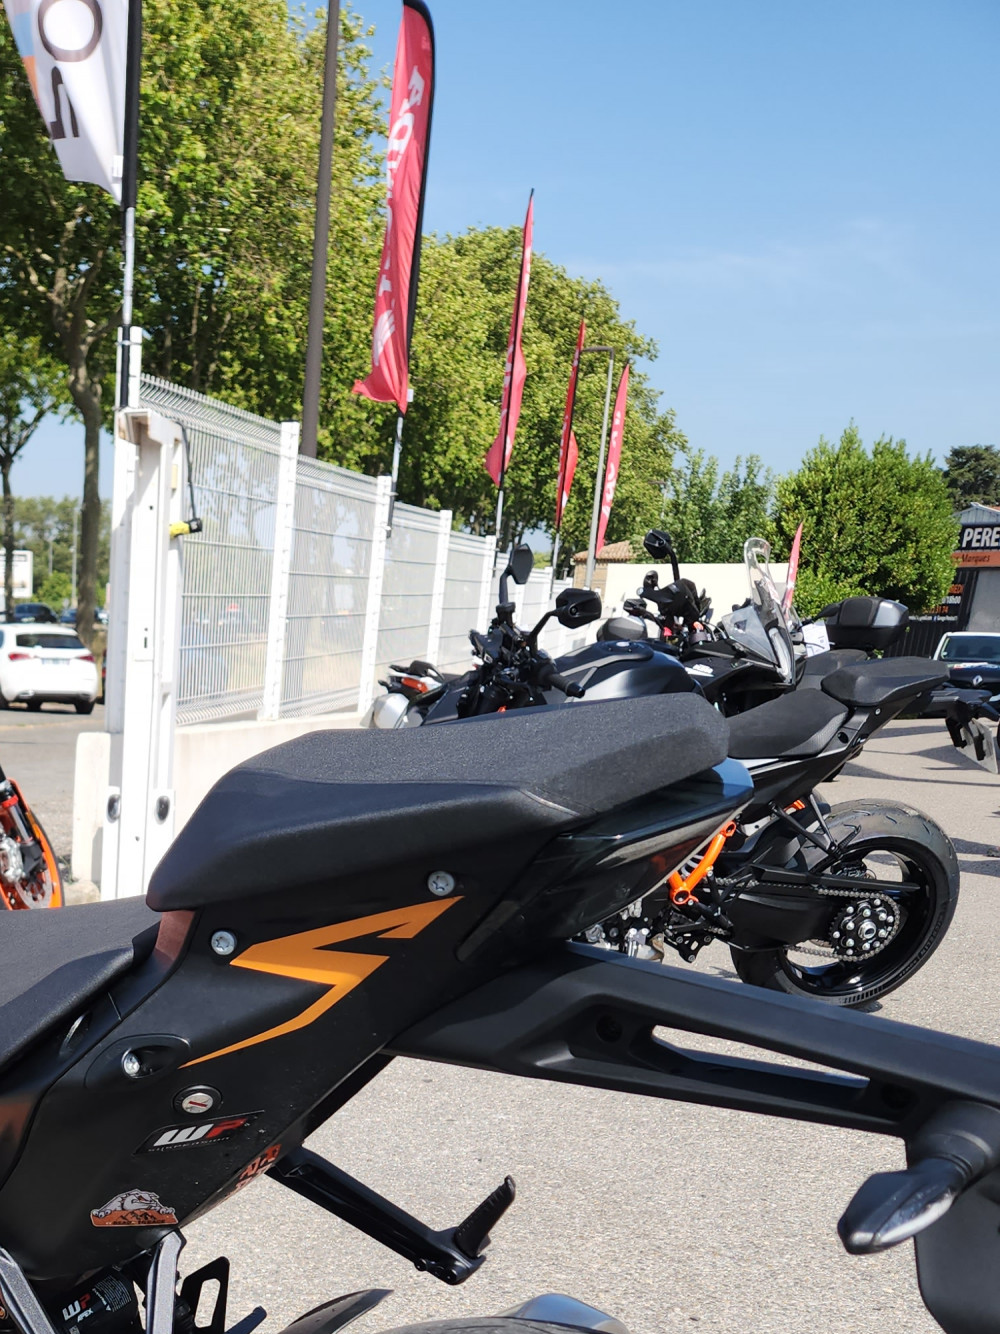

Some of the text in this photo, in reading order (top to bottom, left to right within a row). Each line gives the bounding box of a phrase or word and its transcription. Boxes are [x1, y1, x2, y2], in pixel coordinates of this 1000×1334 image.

[153, 1118, 248, 1147] WP
[62, 1293, 91, 1321] WP
[77, 1307, 94, 1323] APEX
